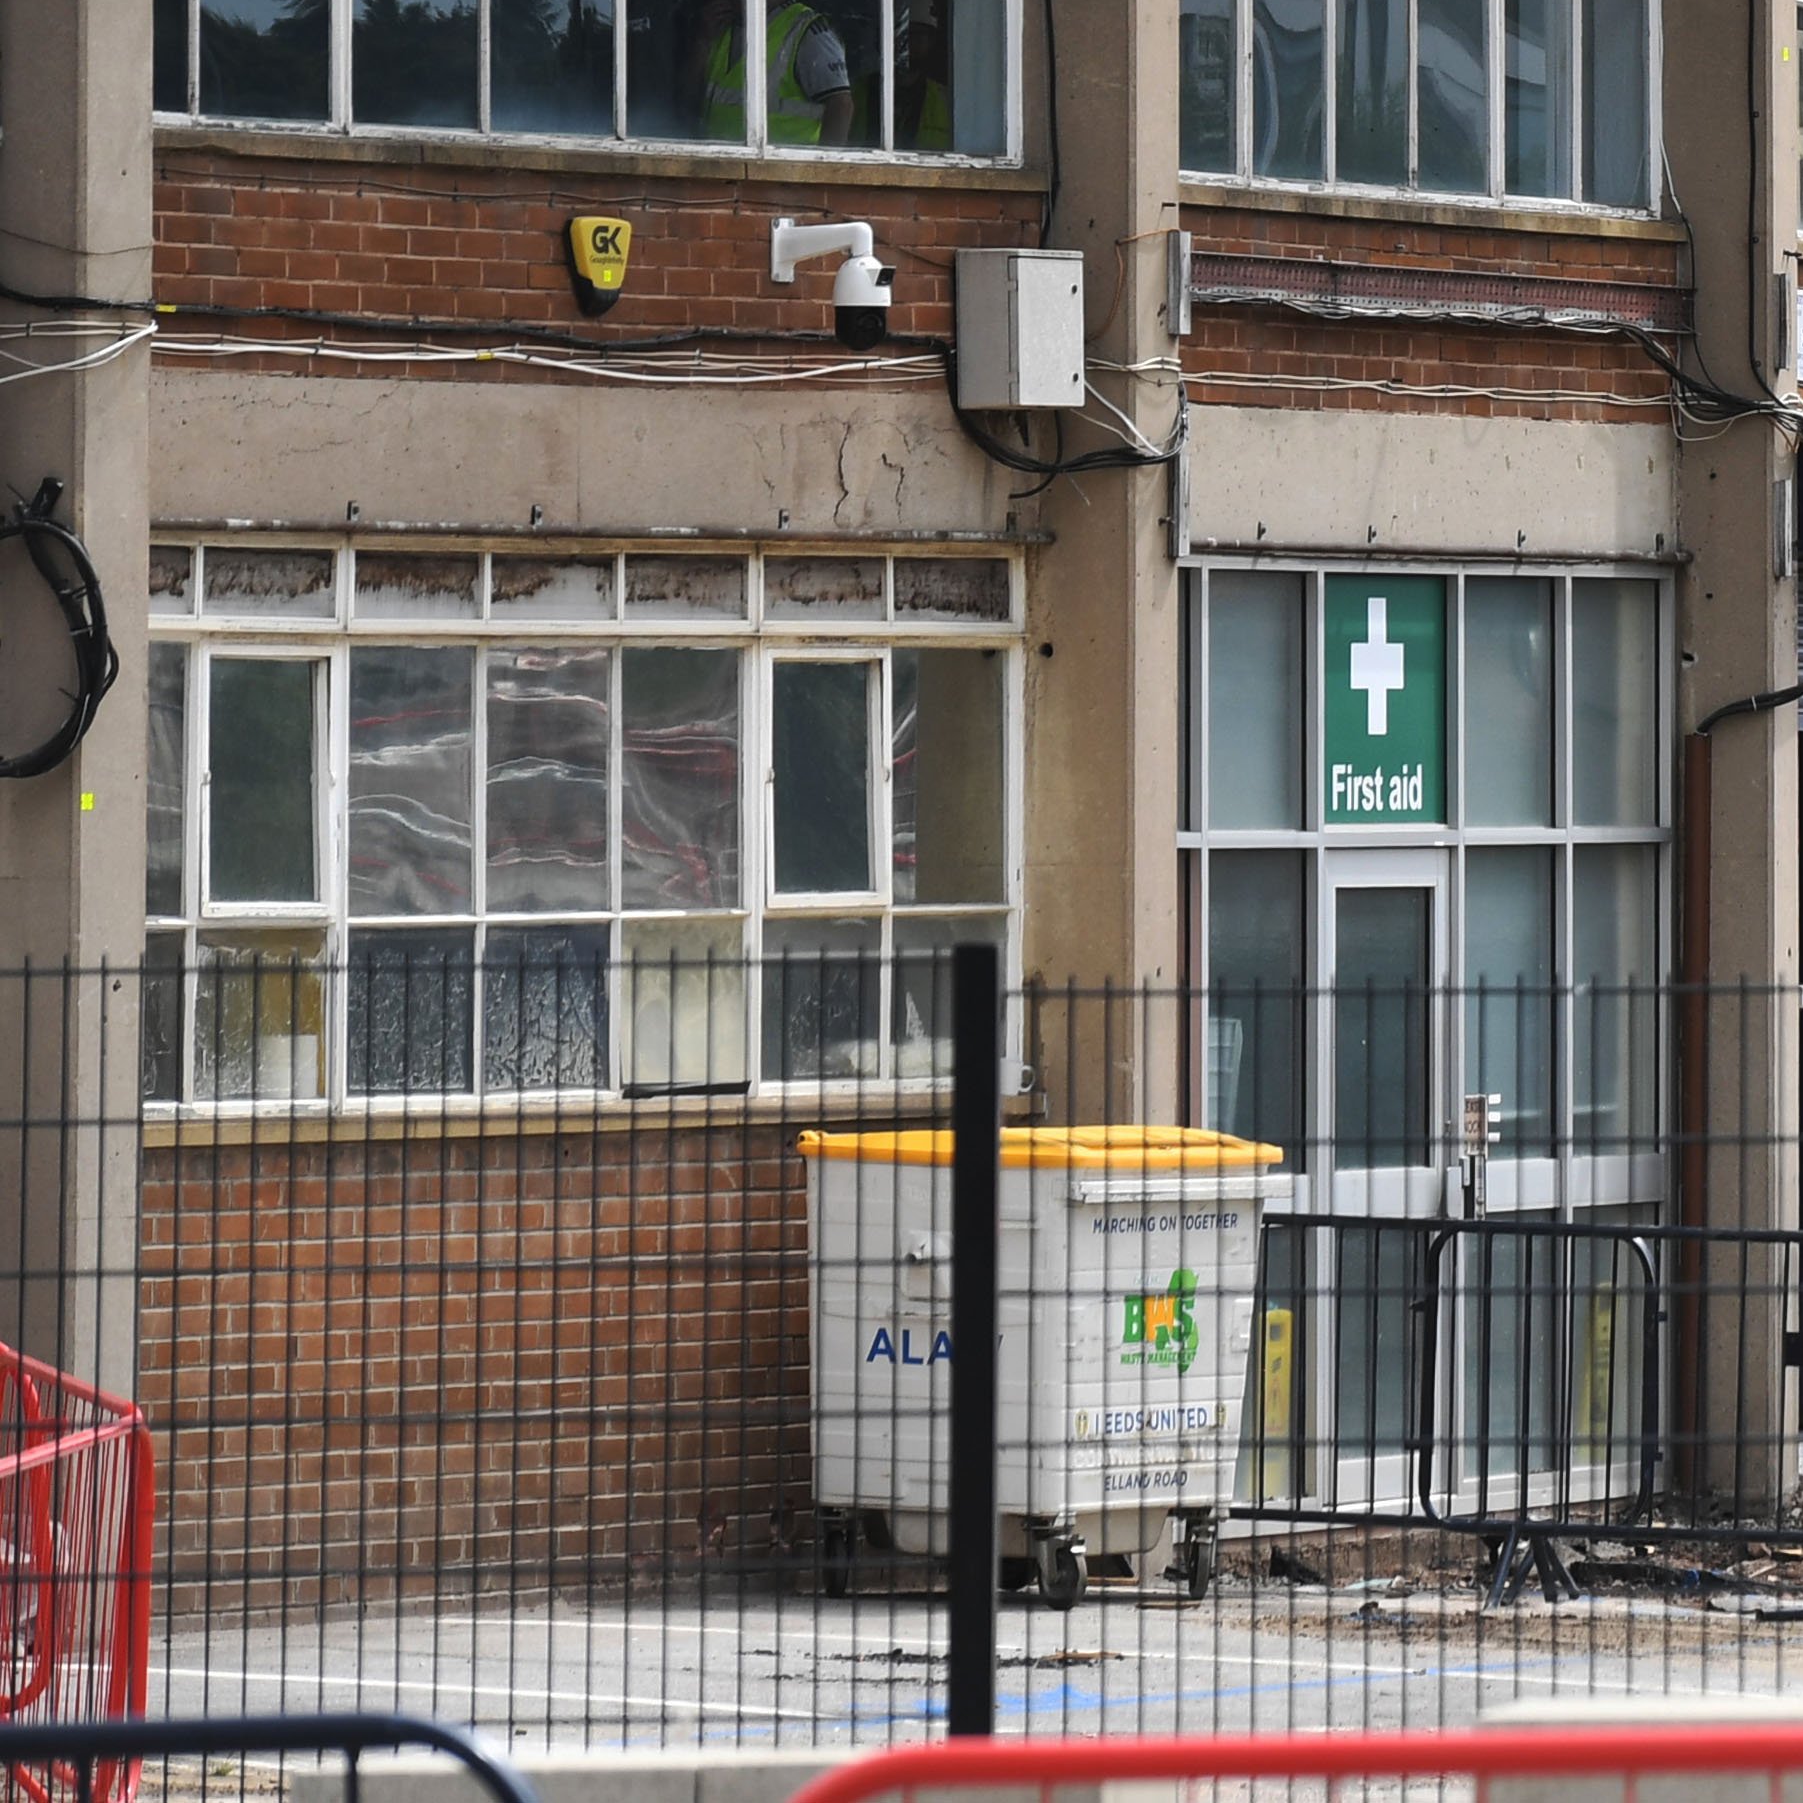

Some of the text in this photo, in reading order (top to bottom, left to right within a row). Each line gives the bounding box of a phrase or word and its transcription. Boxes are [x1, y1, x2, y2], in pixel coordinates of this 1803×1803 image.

[591, 225, 622, 255] GK
[1331, 763, 1423, 811] First aid
[1093, 1213, 1238, 1234] MARCHING ON TOGETHER
[1150, 1407, 1208, 1431] UNITED
[1153, 1470, 1188, 1488] ROAD
